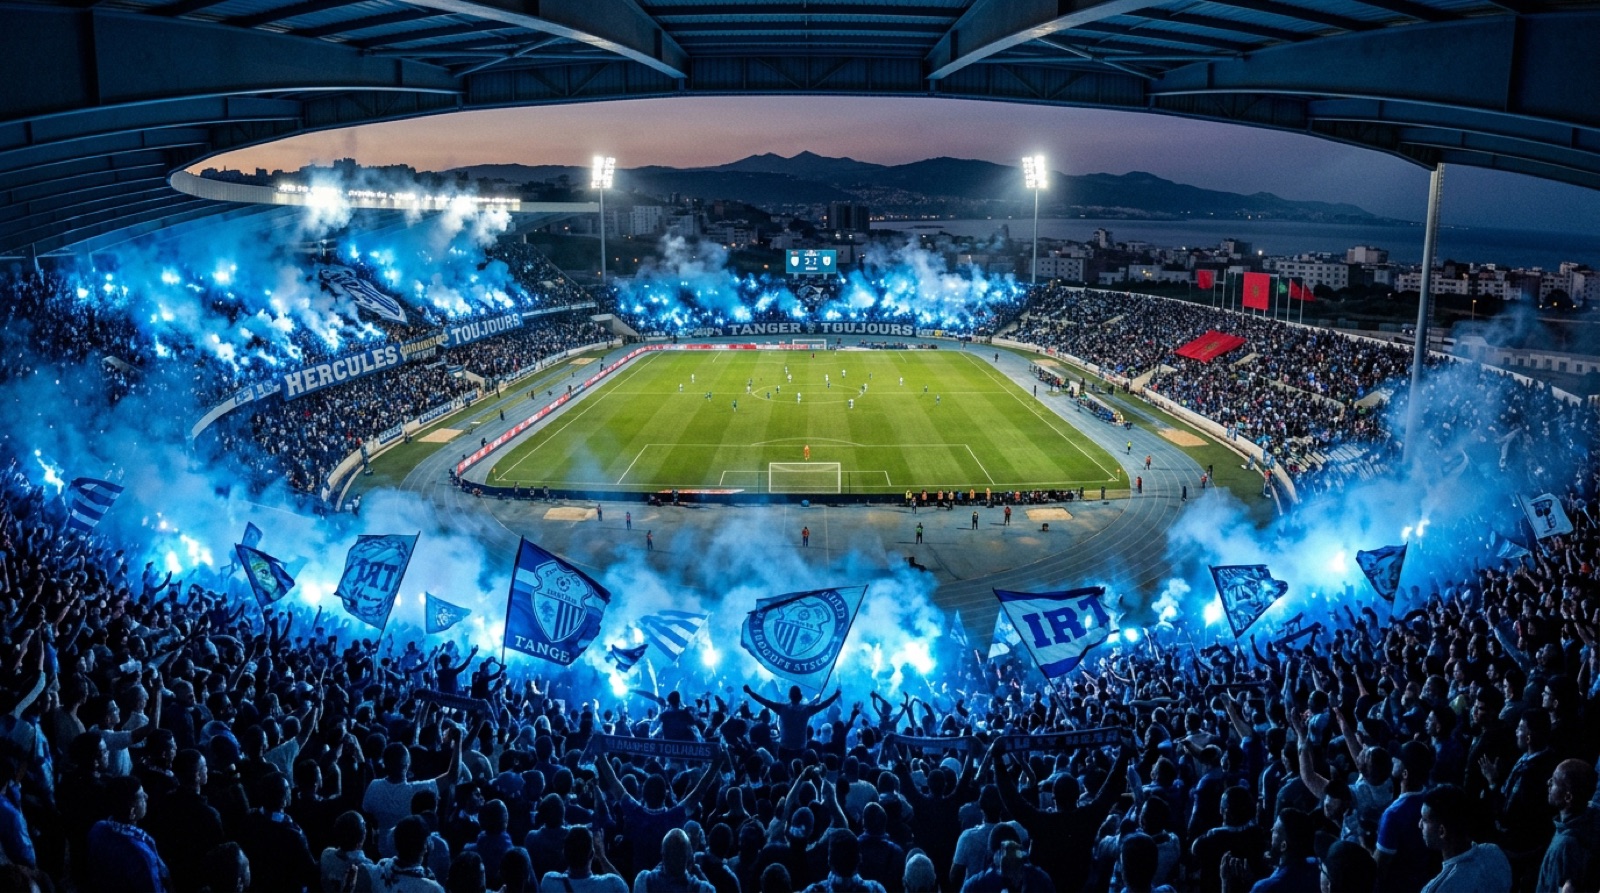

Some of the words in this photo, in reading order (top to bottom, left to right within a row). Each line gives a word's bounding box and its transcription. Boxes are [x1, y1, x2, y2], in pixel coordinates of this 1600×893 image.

[451, 313, 520, 344] TOUJOURS
[728, 322, 801, 336] TANGER
[284, 345, 398, 397] HERCULES
[1022, 595, 1110, 649] IRT
